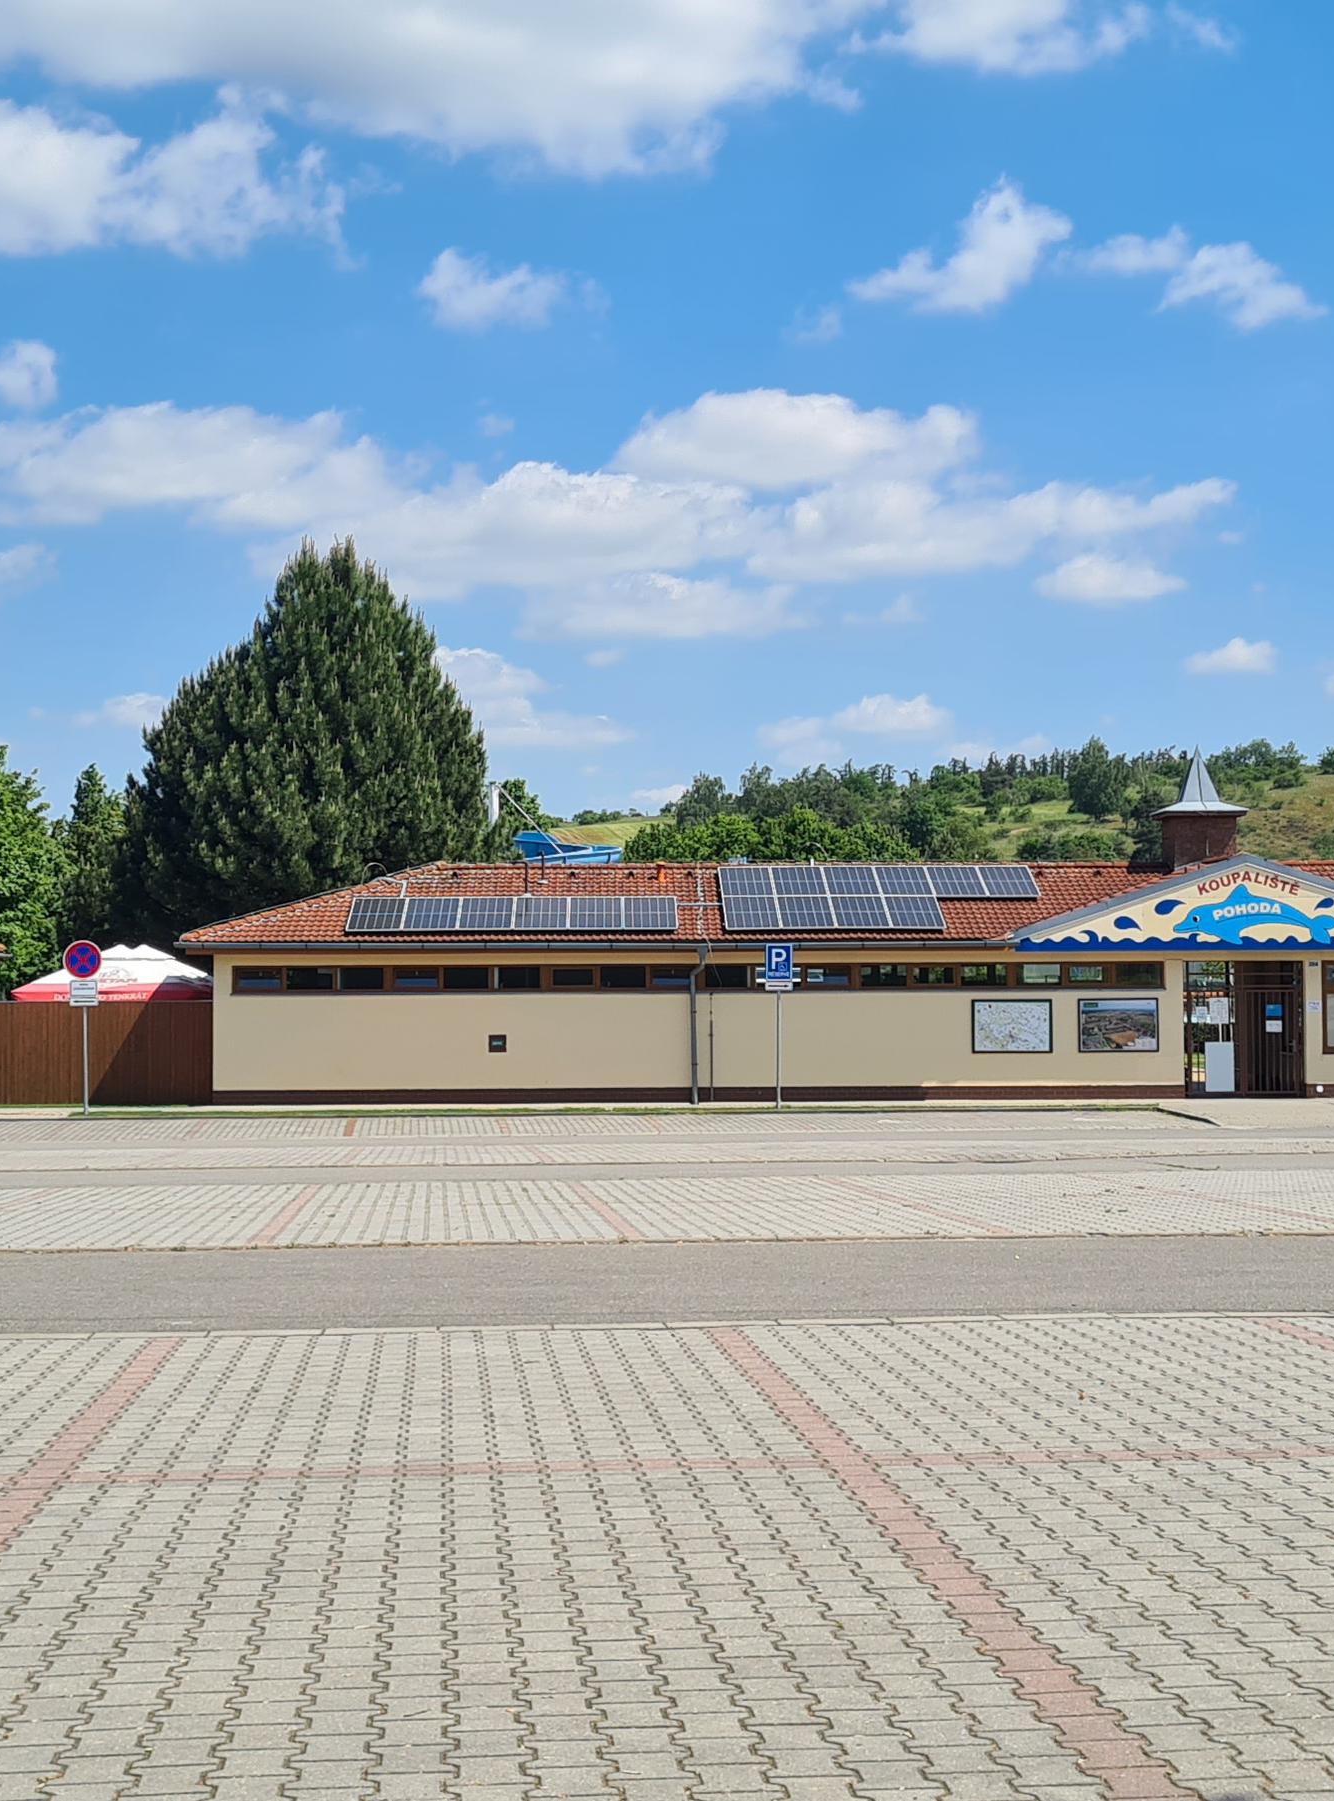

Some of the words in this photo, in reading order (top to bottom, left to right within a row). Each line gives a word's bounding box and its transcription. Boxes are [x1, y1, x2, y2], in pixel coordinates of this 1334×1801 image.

[1197, 870, 1300, 896] KOUPALIŠTĚ
[1212, 902, 1282, 921] POHODA
[771, 948, 787, 970] P
